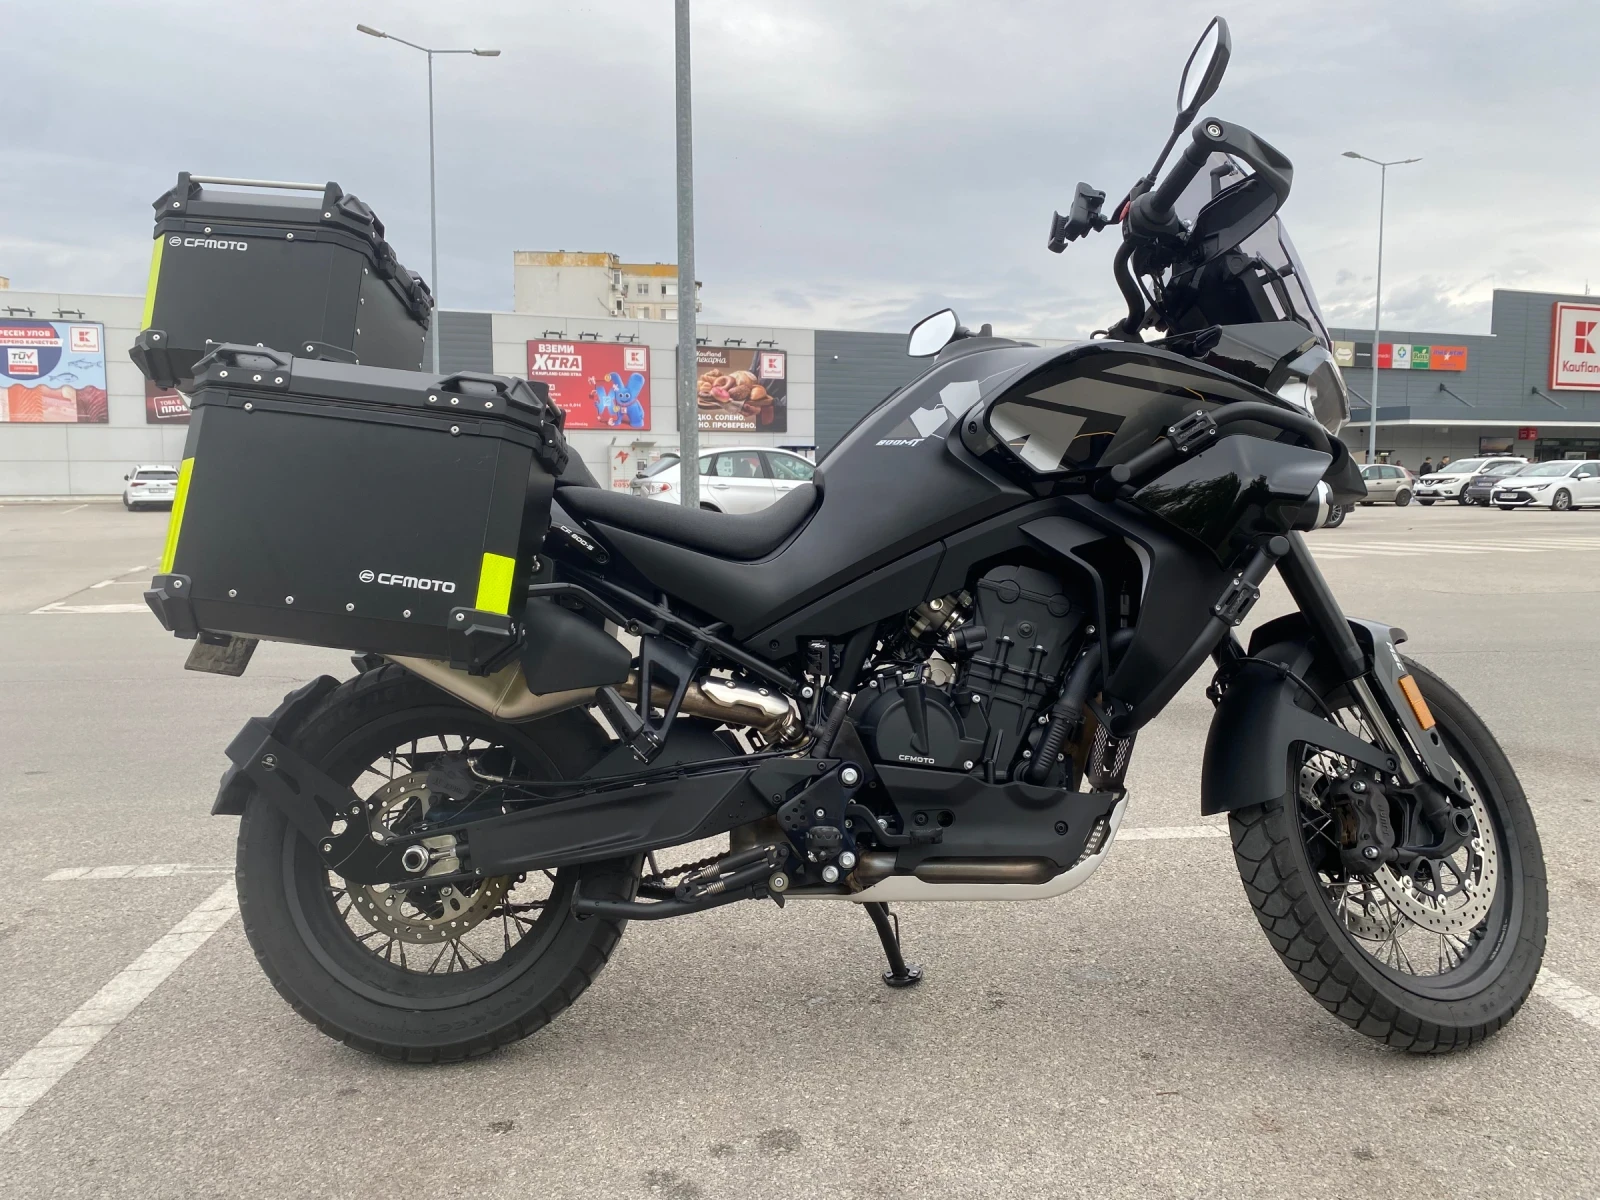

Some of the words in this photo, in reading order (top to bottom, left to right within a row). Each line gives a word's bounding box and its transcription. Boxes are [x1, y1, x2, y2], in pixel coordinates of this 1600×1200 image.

[184, 237, 248, 251] CFMOTO
[538, 343, 575, 354] ВЗЕМИ
[532, 354, 582, 371] XTRA
[1562, 360, 1600, 373] Kauflan
[377, 572, 456, 594] CFMOTO
[898, 754, 935, 765] CFMOTO
